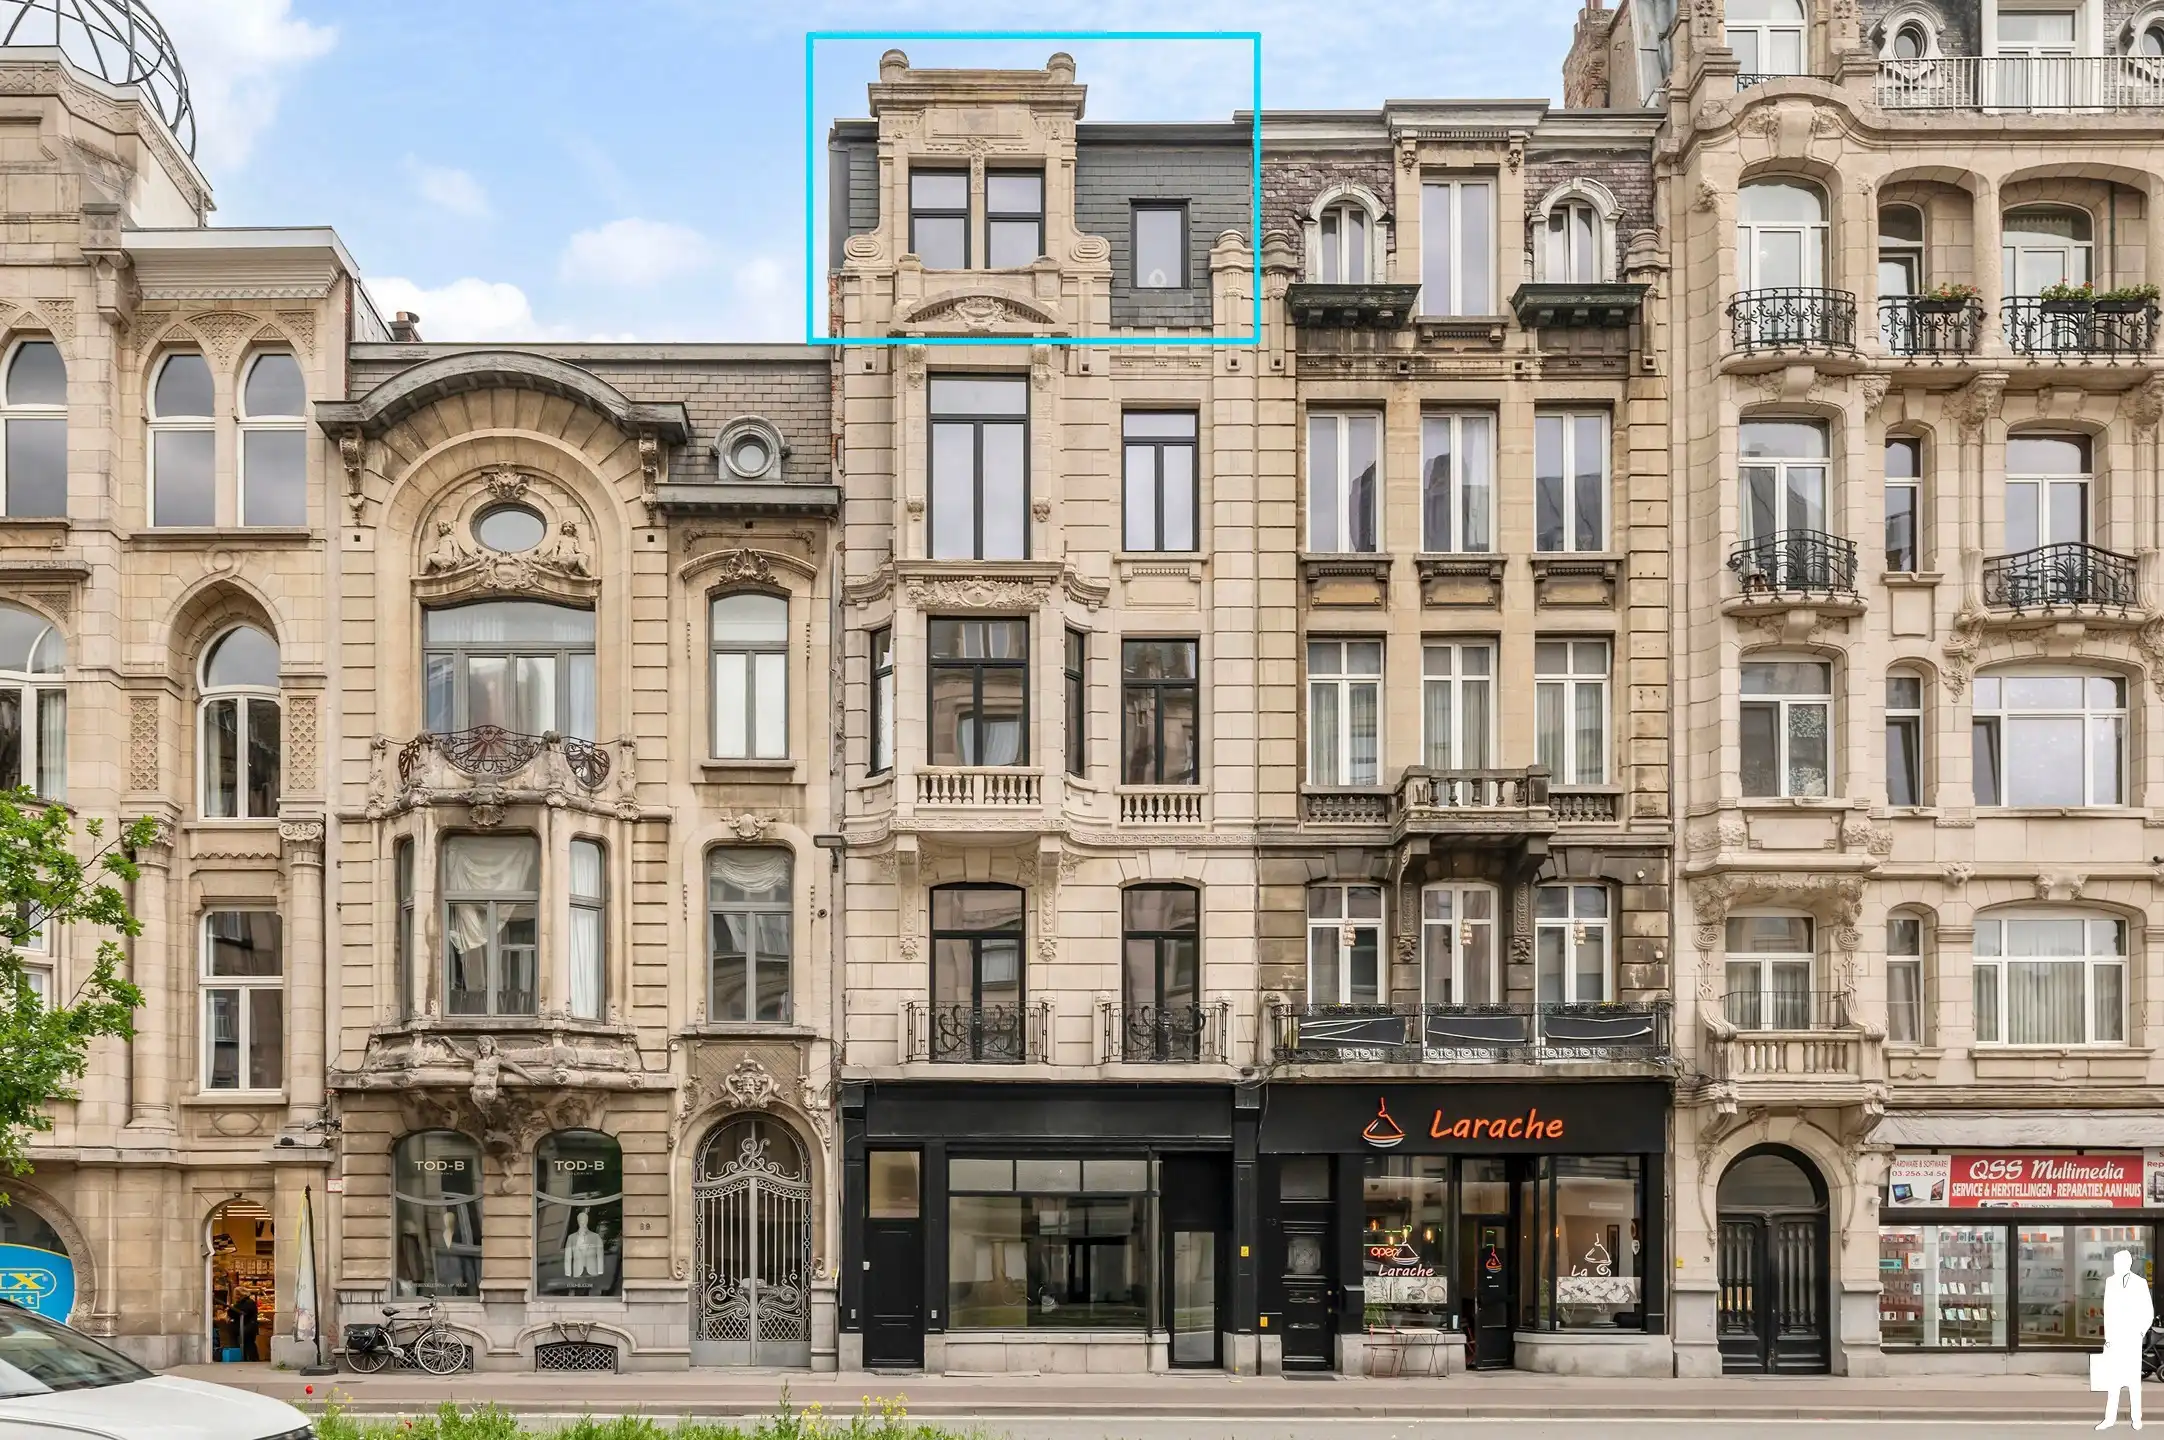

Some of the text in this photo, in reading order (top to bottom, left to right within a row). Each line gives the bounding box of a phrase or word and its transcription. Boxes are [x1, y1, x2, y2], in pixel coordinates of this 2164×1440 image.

[1430, 1108, 1564, 1139] Larache
[414, 1160, 465, 1171] TOD-B
[554, 1160, 605, 1171] TOD-B
[1923, 1160, 1947, 1168] SOFTWARE
[1969, 1160, 2125, 1180] QSS Multimedia
[1952, 1183, 1983, 1197] SERVICE
[1984, 1183, 1991, 1197] &
[1992, 1183, 2053, 1197] HERSTELLINGEN
[2057, 1183, 2103, 1197] REPARATIES
[2104, 1183, 2122, 1197] AAN
[2123, 1183, 2142, 1197] HUIS
[1371, 1247, 1398, 1258] open
[1378, 1264, 1435, 1277] Larache
[1571, 1264, 1588, 1277] La
